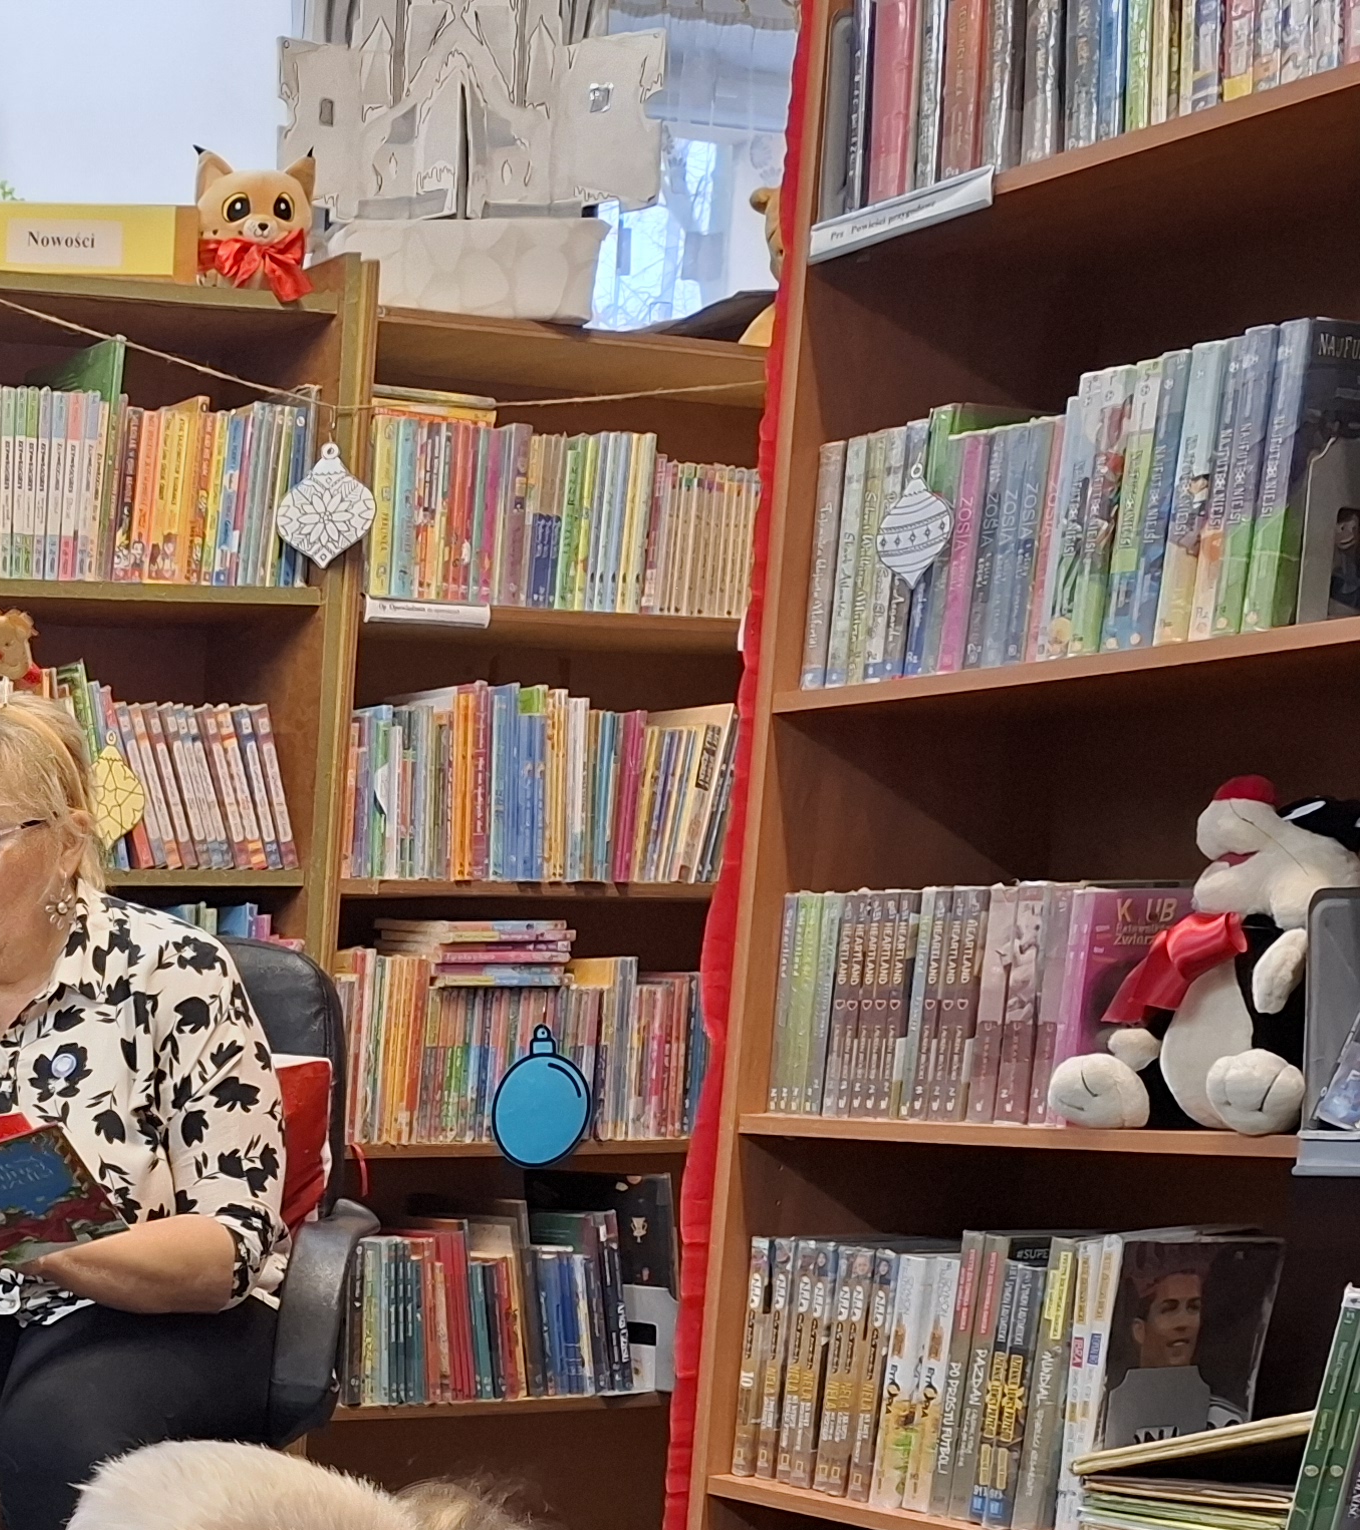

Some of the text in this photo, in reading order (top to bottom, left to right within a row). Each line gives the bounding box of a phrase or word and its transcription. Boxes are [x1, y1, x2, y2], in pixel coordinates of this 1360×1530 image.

[27, 230, 95, 249] Nowości
[1318, 333, 1360, 360] NAJFU
[954, 496, 973, 551] ZOSIA
[980, 494, 999, 548] ZOSIA
[998, 490, 1018, 546] ZOSIA
[1021, 482, 1039, 539] ZOSIA
[1117, 898, 1177, 922] KUB
[837, 924, 853, 985] HEARTLAND
[849, 924, 866, 986] HEARTLAND
[864, 923, 880, 985] HEARTLAND
[877, 922, 893, 984] HEARTLAND
[891, 922, 908, 984] HEARTLAND
[927, 920, 944, 984] HEARTLAND
[945, 920, 962, 984] HEARTLAND
[960, 919, 977, 984] HEARTLAND
[1016, 1248, 1049, 1260] #SUPE
[748, 1274, 760, 1309] Nela
[774, 1274, 785, 1309] Nela
[798, 1276, 810, 1312] Nela
[811, 1282, 824, 1317] Nela
[837, 1286, 850, 1321] Nela
[850, 1286, 864, 1321] Nela
[872, 1290, 885, 1327] Nela
[949, 1362, 961, 1376] PO
[1072, 1338, 1083, 1366] IBRA
[741, 1371, 755, 1388] 10
[764, 1367, 777, 1395] NELA
[787, 1366, 800, 1393] NELA
[801, 1372, 816, 1401] NELA
[968, 1349, 988, 1406] PAZDAN
[825, 1381, 839, 1410] NELA
[838, 1382, 851, 1409] NELA
[859, 1383, 874, 1412] NELA
[943, 1379, 959, 1425] PROSTU
